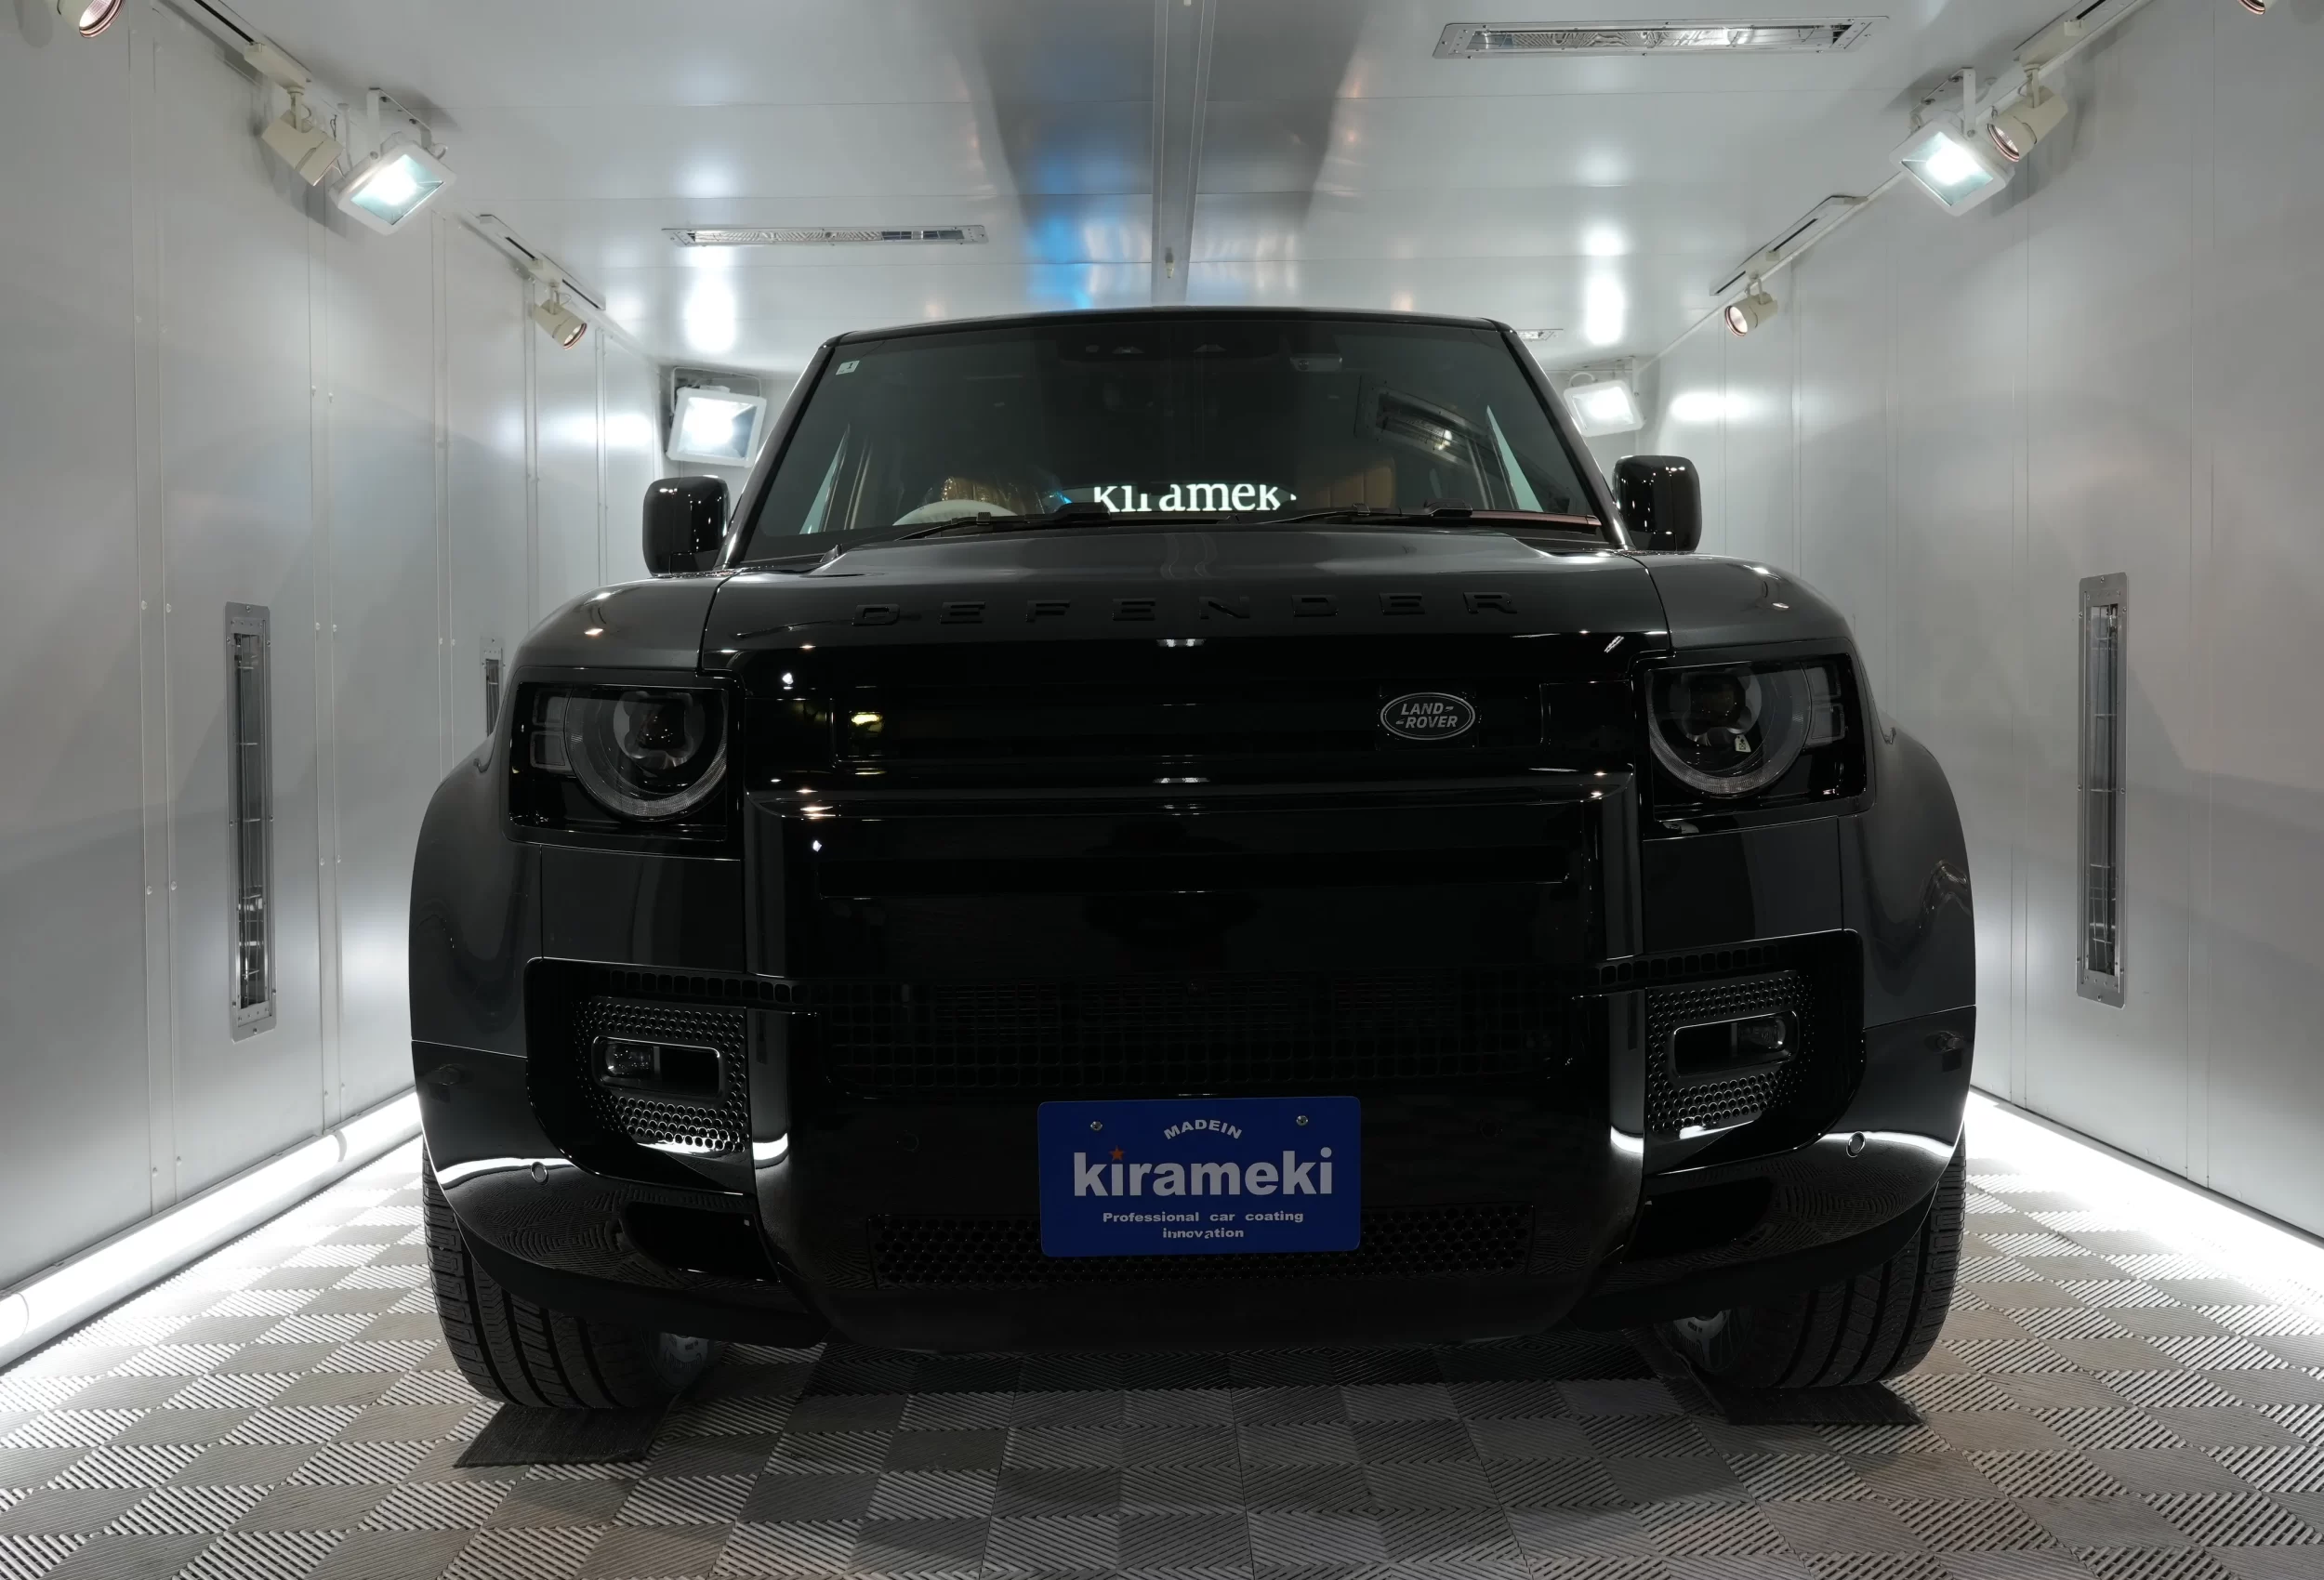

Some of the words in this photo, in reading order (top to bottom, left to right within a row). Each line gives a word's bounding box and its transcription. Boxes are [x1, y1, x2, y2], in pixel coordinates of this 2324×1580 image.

[852, 591, 1518, 627] DEFENDER
[1400, 702, 1444, 716] LAND
[1405, 715, 1459, 729] ROVER
[1073, 1145, 1333, 1197] kirameki
[1103, 1210, 1199, 1223] Professional
[1209, 1212, 1235, 1222] car
[1245, 1210, 1304, 1224] coating
[1162, 1226, 1245, 1240] innovation
